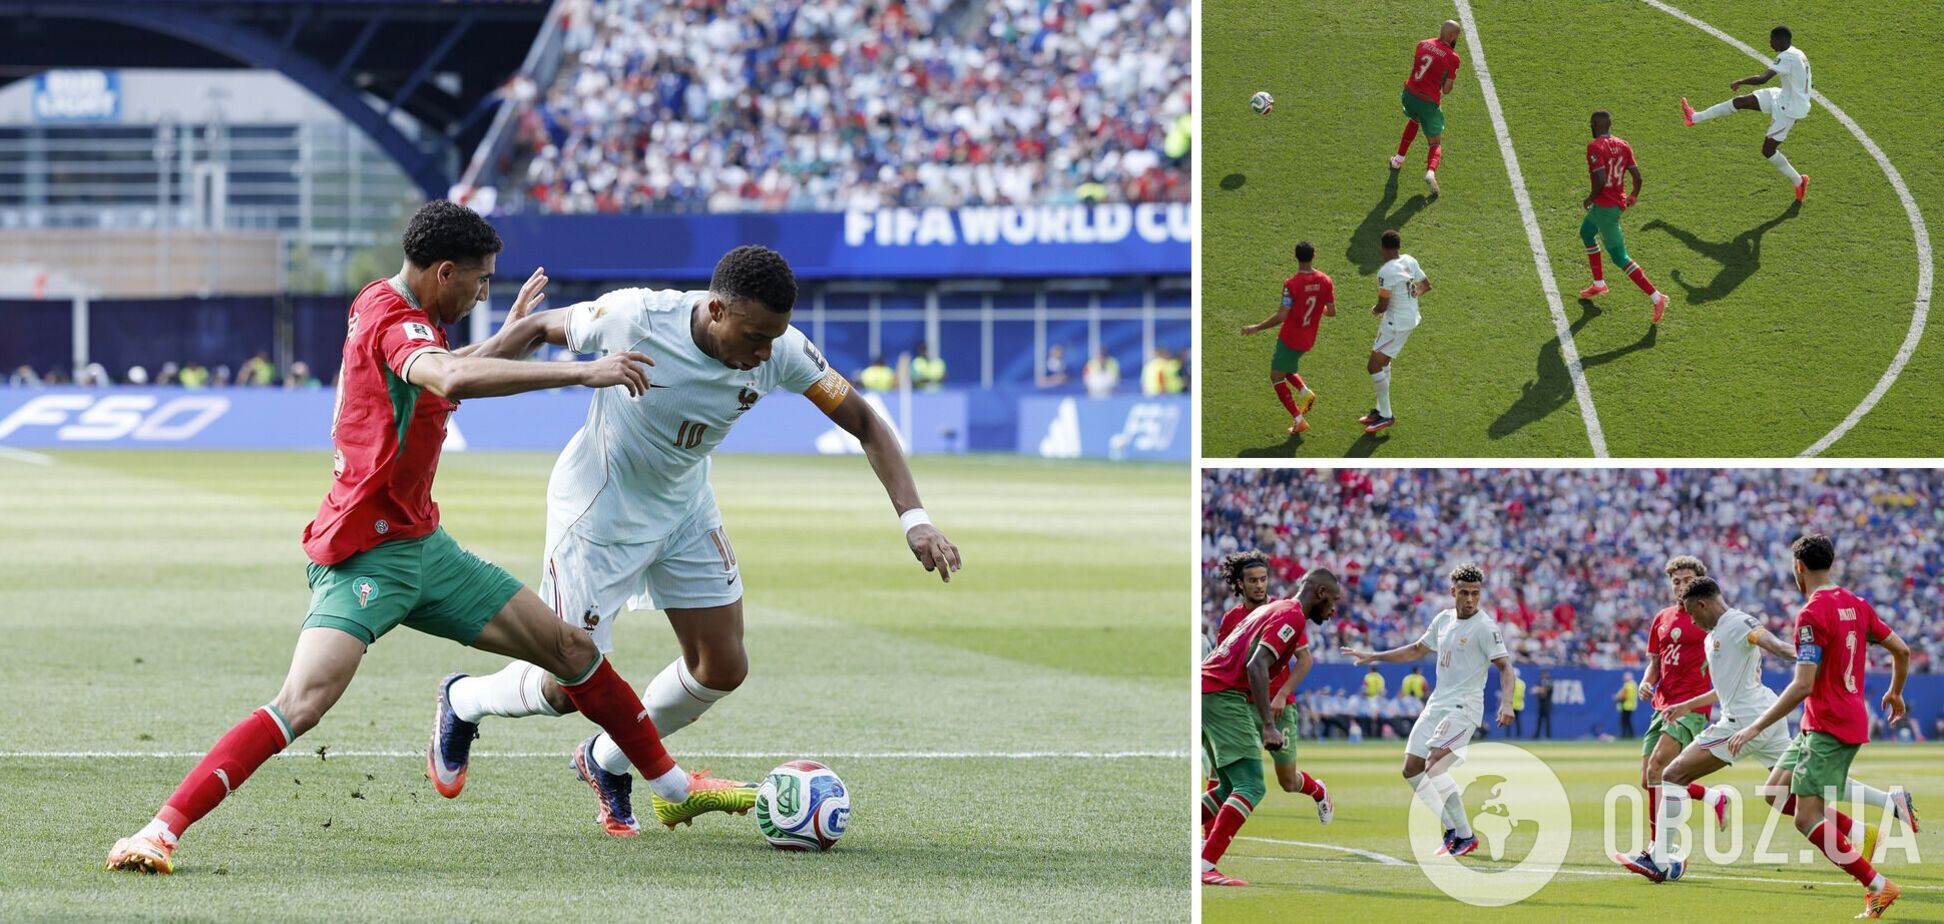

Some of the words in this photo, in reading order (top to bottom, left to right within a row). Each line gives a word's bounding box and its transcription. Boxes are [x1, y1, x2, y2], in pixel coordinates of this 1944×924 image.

[1415, 54, 1433, 80] 3
[1605, 156, 1624, 187] 14
[844, 203, 956, 246] FIFA
[959, 204, 1132, 245] WORLD
[1302, 295, 1317, 327] 2
[673, 420, 708, 449] 10
[1664, 643, 1682, 665] 24
[1843, 630, 1857, 694] 2
[1551, 680, 1585, 704] IFA
[1796, 744, 1811, 775] 2
